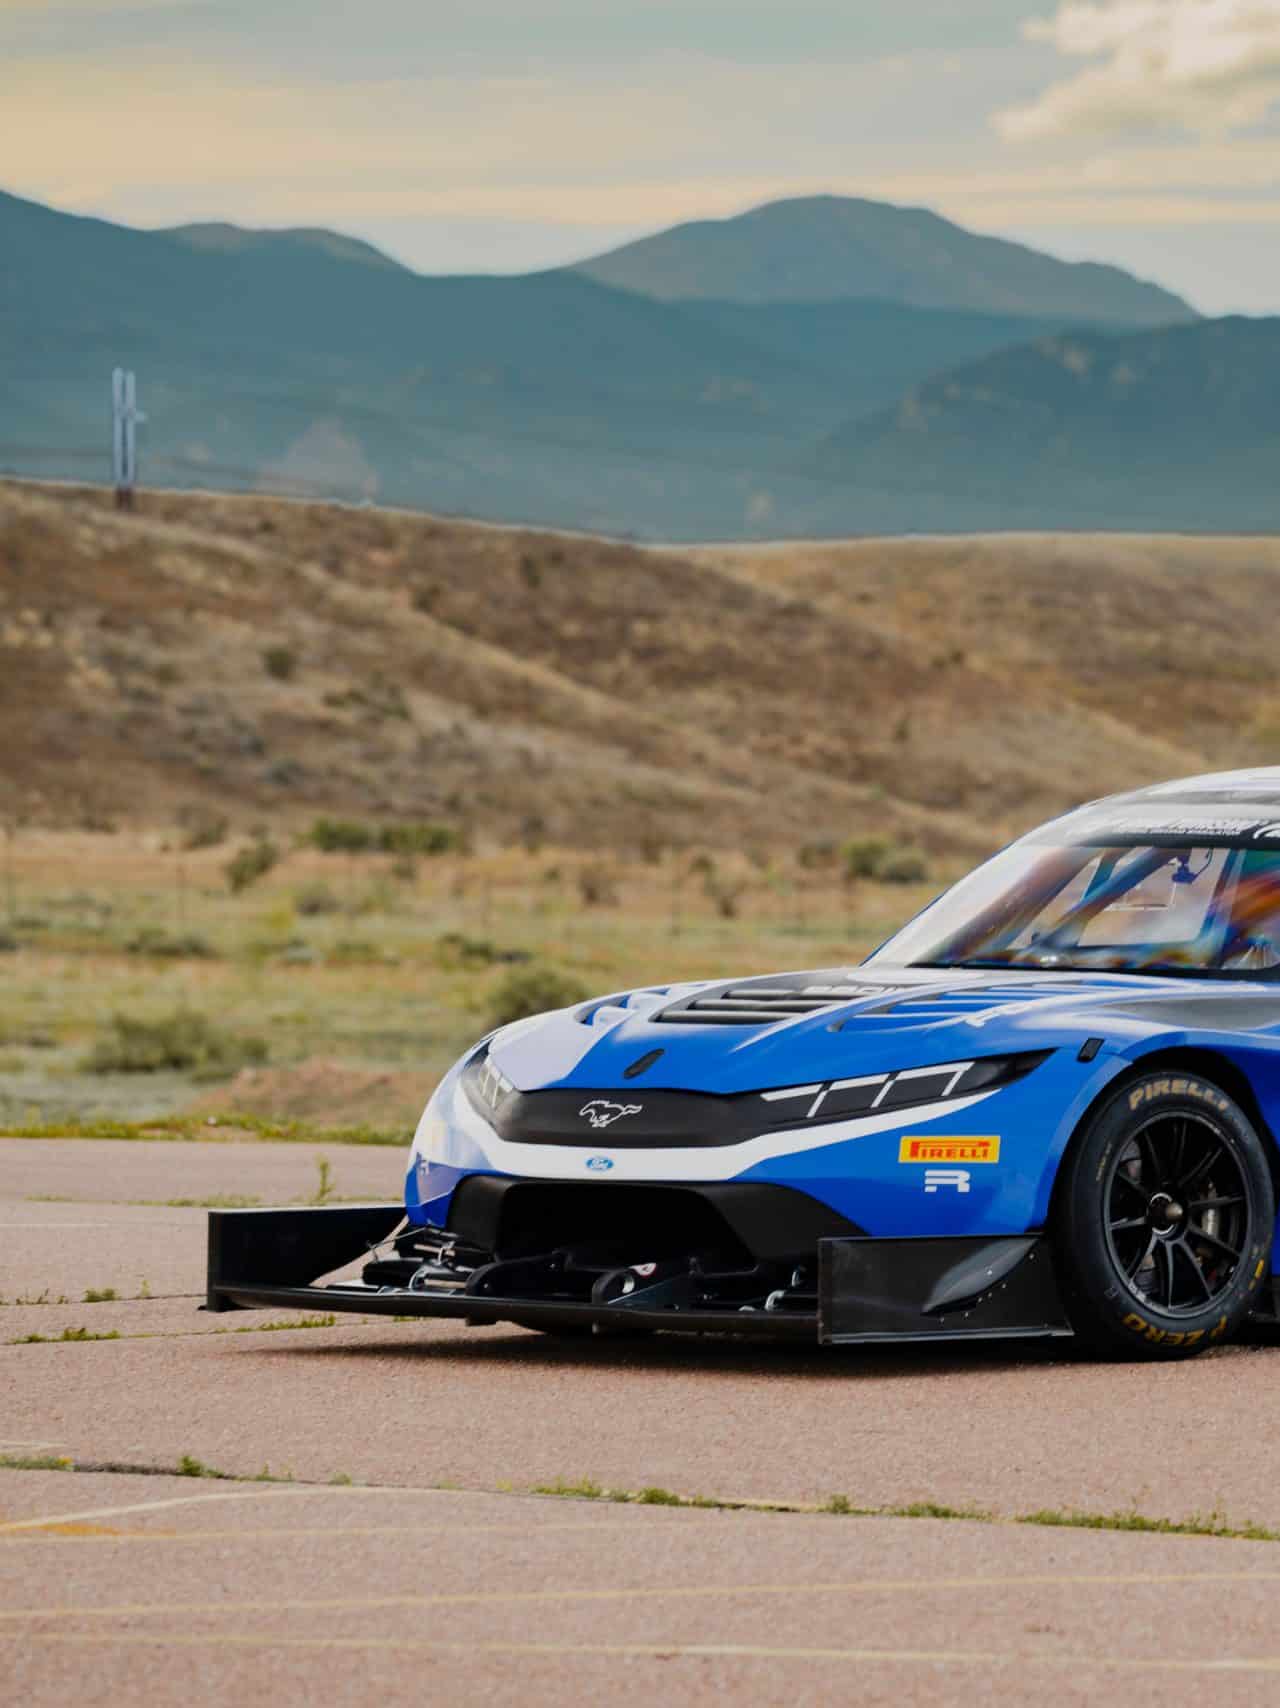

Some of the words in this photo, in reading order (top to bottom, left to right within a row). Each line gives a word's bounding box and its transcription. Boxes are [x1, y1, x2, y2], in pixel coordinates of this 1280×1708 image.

[1129, 1079, 1230, 1112] PIRELLI
[909, 1141, 991, 1159] PIRELLI
[1121, 1312, 1206, 1347] ZERO
